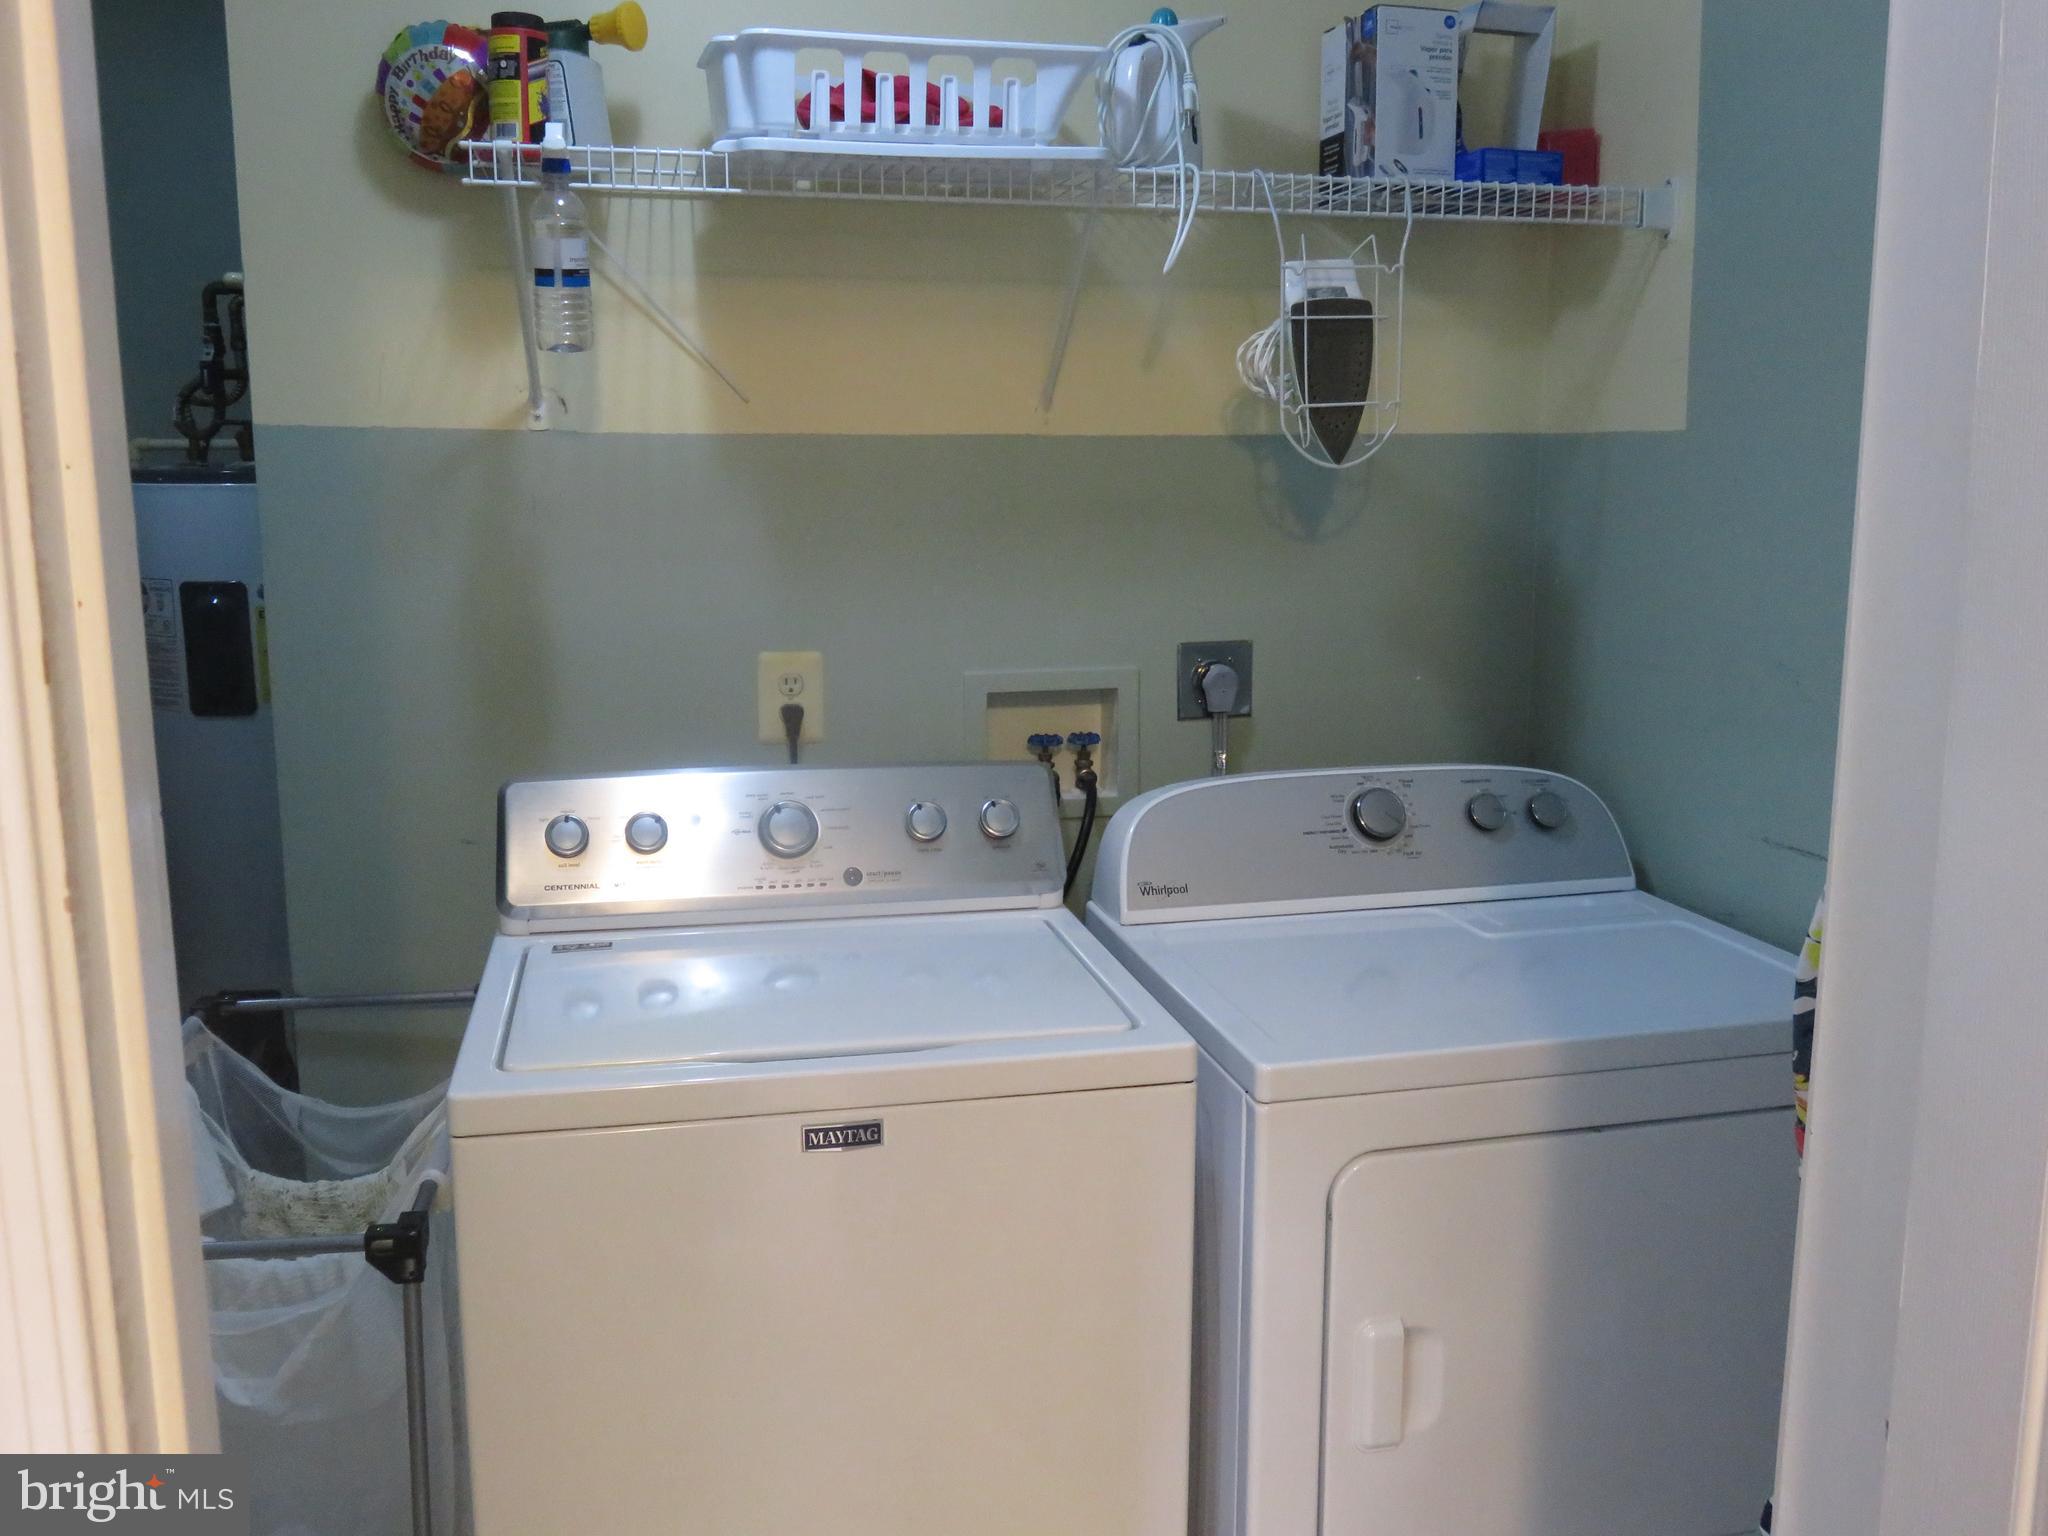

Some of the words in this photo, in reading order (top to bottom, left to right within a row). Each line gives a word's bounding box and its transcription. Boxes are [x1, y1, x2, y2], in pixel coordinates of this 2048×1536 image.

[544, 883, 600, 892] CENTENNIAL
[1139, 883, 1189, 898] Whirlpool
[808, 1127, 879, 1146] MAYTAG
